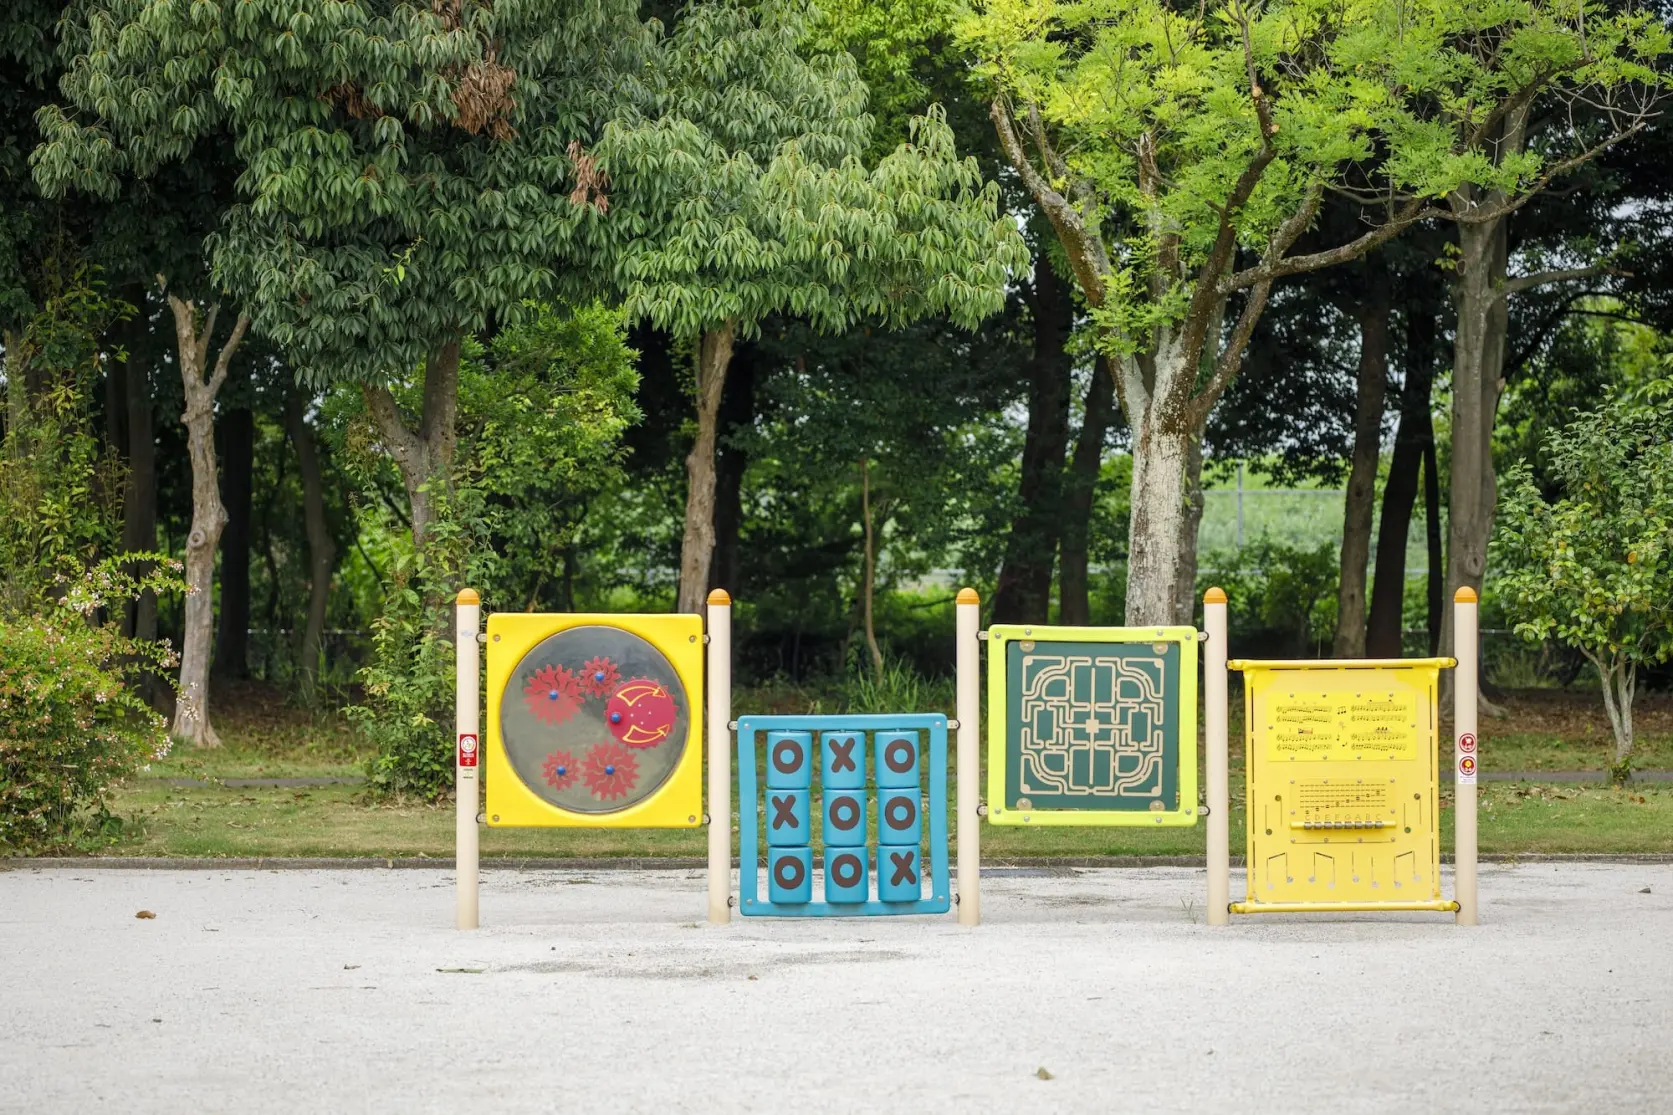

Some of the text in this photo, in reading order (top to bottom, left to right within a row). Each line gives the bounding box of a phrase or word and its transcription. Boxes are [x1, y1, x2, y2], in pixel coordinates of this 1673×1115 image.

[773, 738, 915, 774] O X O
[772, 795, 915, 830] X O O
[774, 851, 916, 890] O O X
